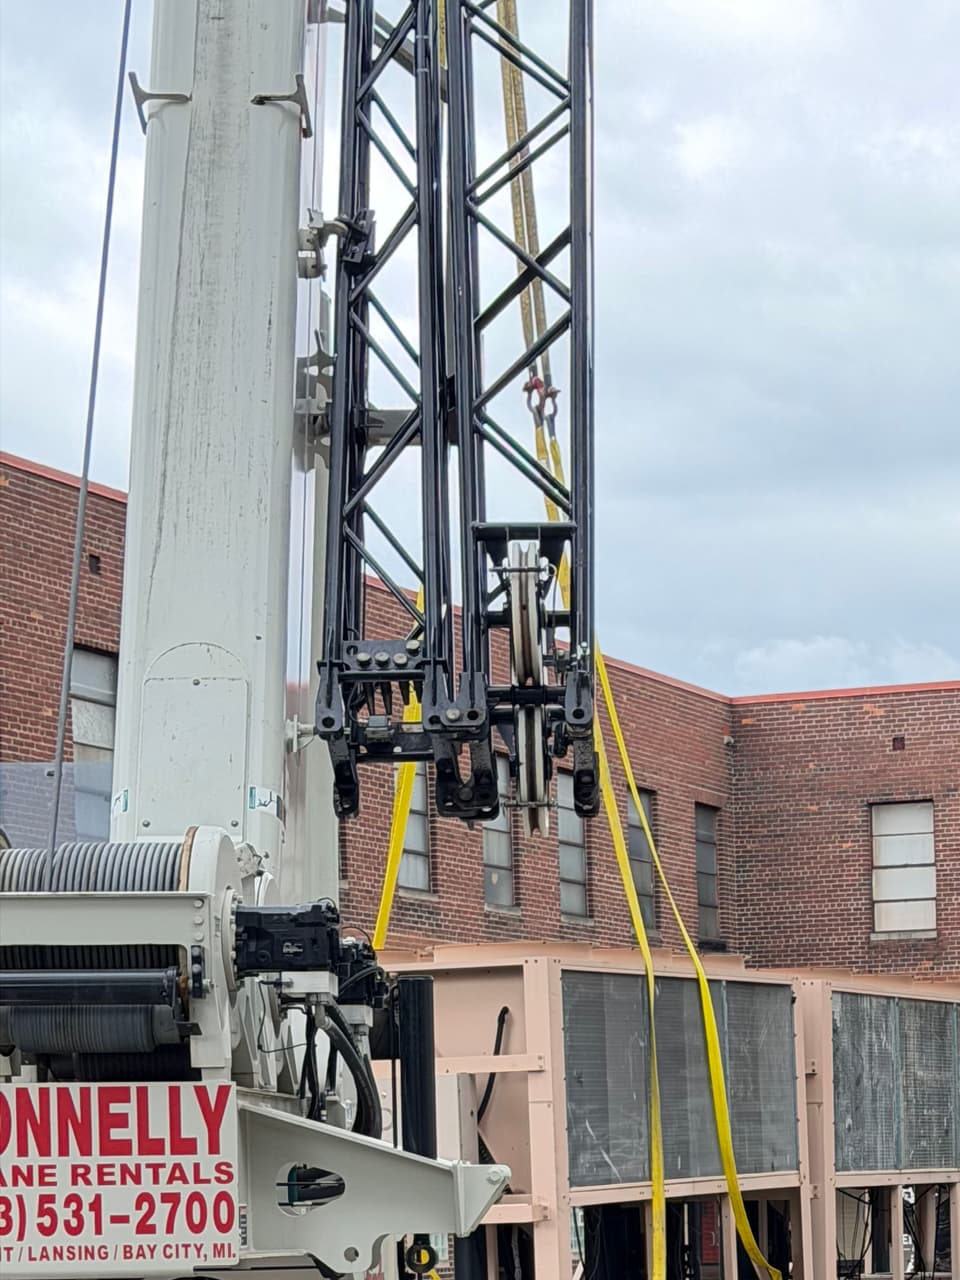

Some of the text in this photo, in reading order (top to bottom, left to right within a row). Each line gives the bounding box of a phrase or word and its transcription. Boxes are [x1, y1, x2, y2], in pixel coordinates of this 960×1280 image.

[71, 1162, 234, 1186] RENTALS
[36, 1191, 235, 1237] 531-2700
[28, 1244, 109, 1262] LANSING
[123, 1244, 157, 1260] BAY
[162, 1243, 208, 1261] CITY,
[212, 1242, 236, 1259] MI.
